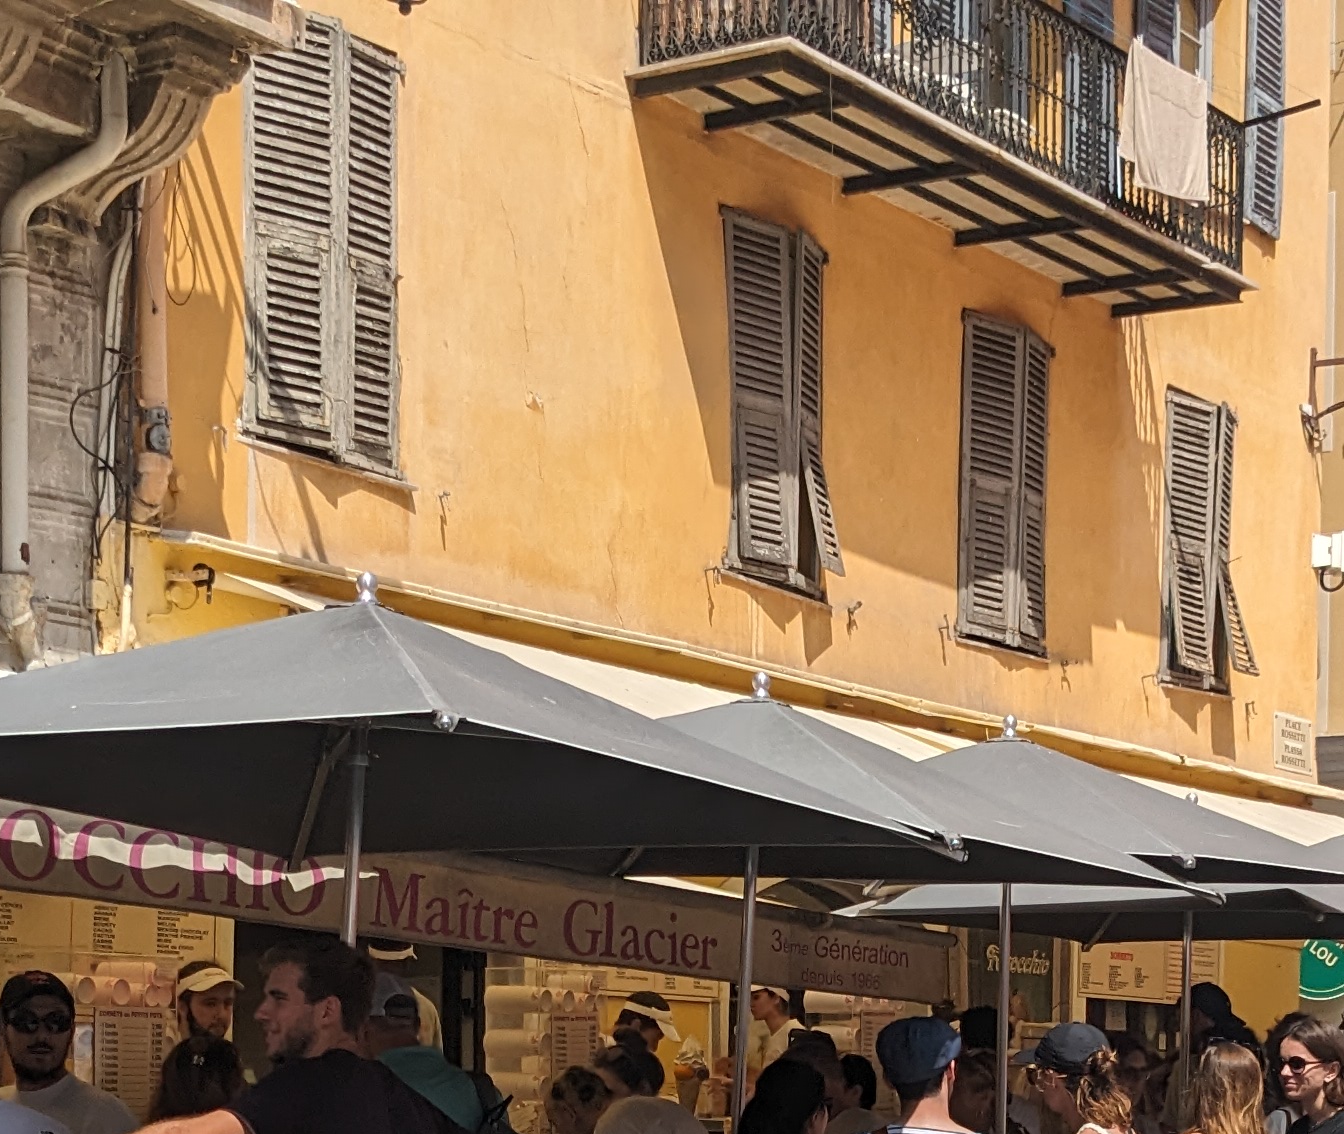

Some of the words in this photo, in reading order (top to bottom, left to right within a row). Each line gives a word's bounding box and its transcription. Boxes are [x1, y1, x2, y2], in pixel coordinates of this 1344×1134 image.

[1285, 718, 1302, 732] PLACE
[1281, 728, 1306, 743] ROSSETTI
[1284, 742, 1303, 756] PLASSA
[1281, 753, 1306, 769] ROSSETTI
[369, 865, 539, 949] Maître
[563, 898, 718, 971] Glacier
[815, 935, 910, 969] Génération
[1308, 940, 1339, 967] LOU
[801, 967, 844, 988] depuis
[851, 971, 881, 991] 1966
